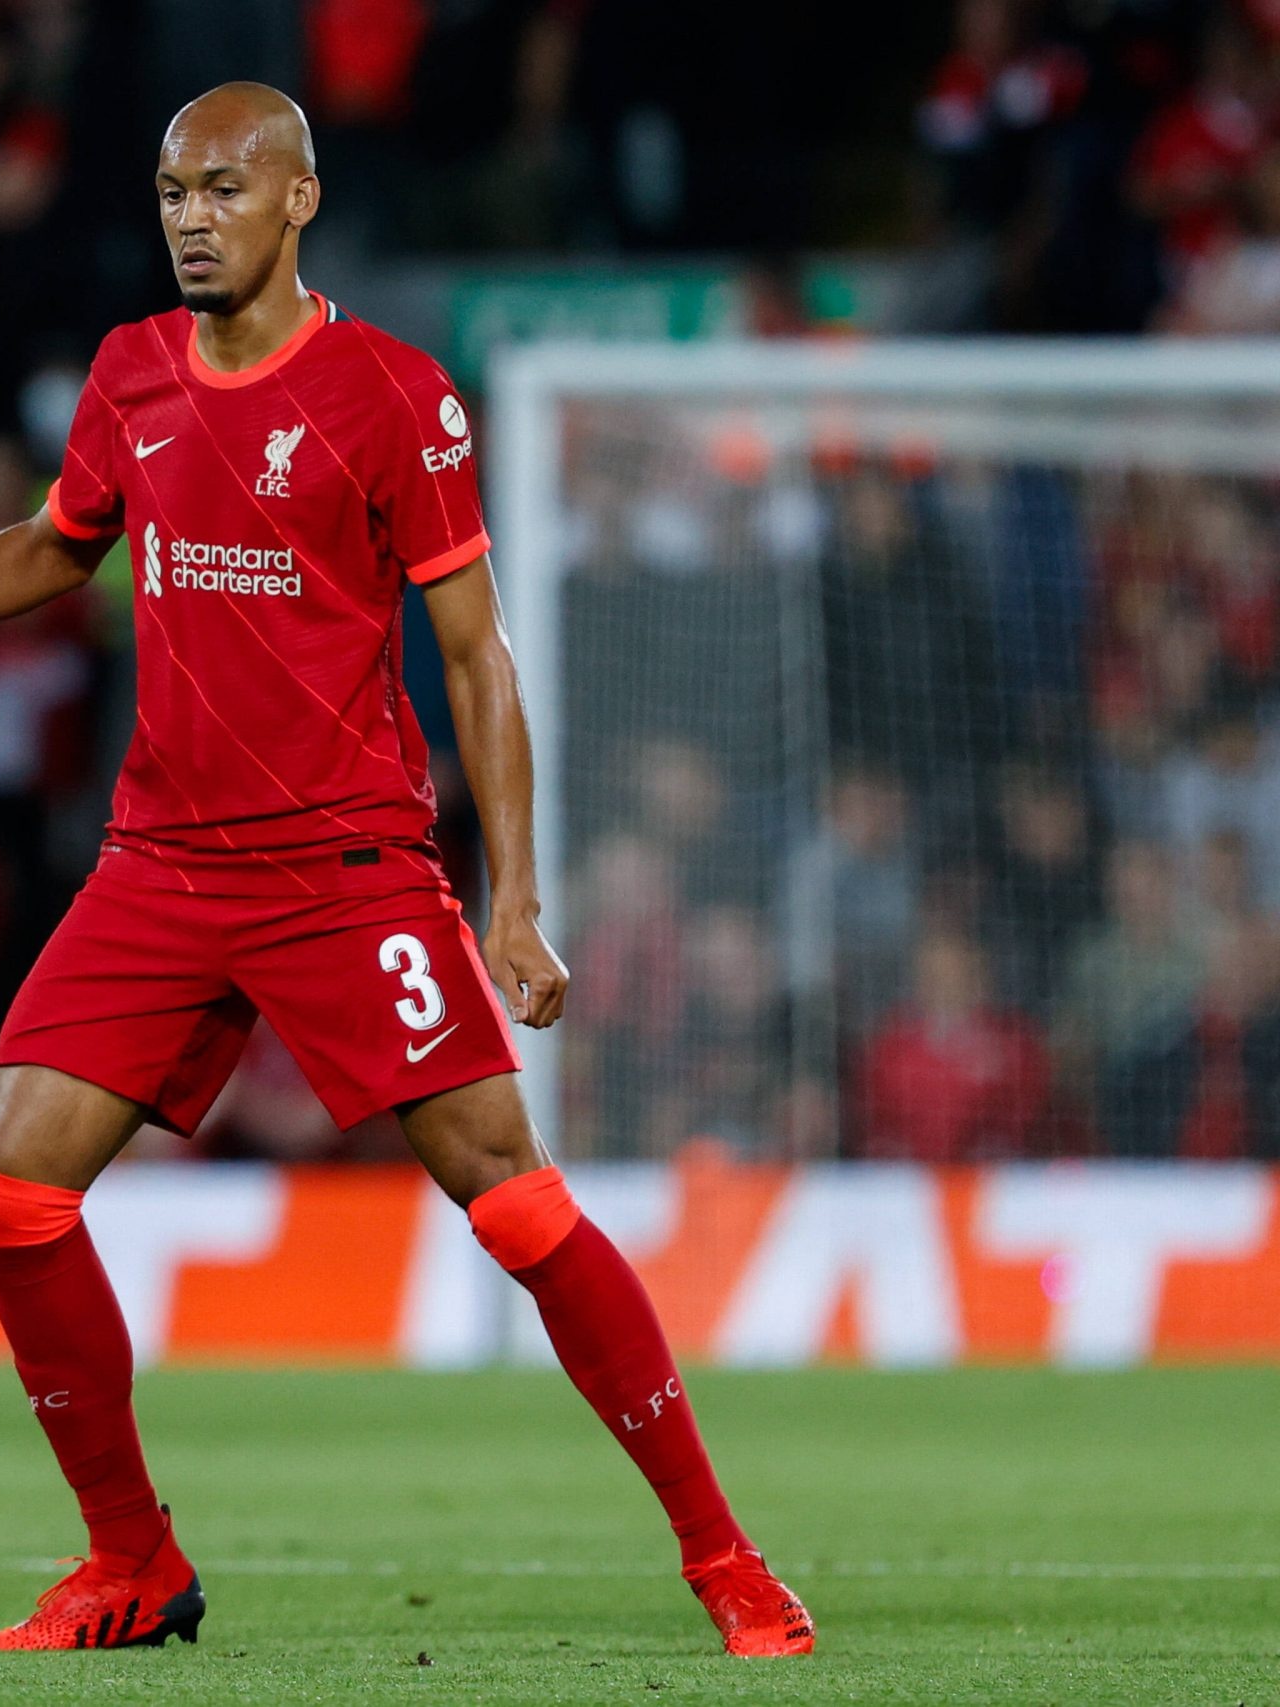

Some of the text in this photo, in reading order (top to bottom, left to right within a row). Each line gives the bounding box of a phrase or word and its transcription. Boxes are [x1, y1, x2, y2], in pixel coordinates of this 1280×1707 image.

[171, 538, 292, 571] standard
[172, 564, 301, 597] chartered
[379, 933, 447, 1031] 3
